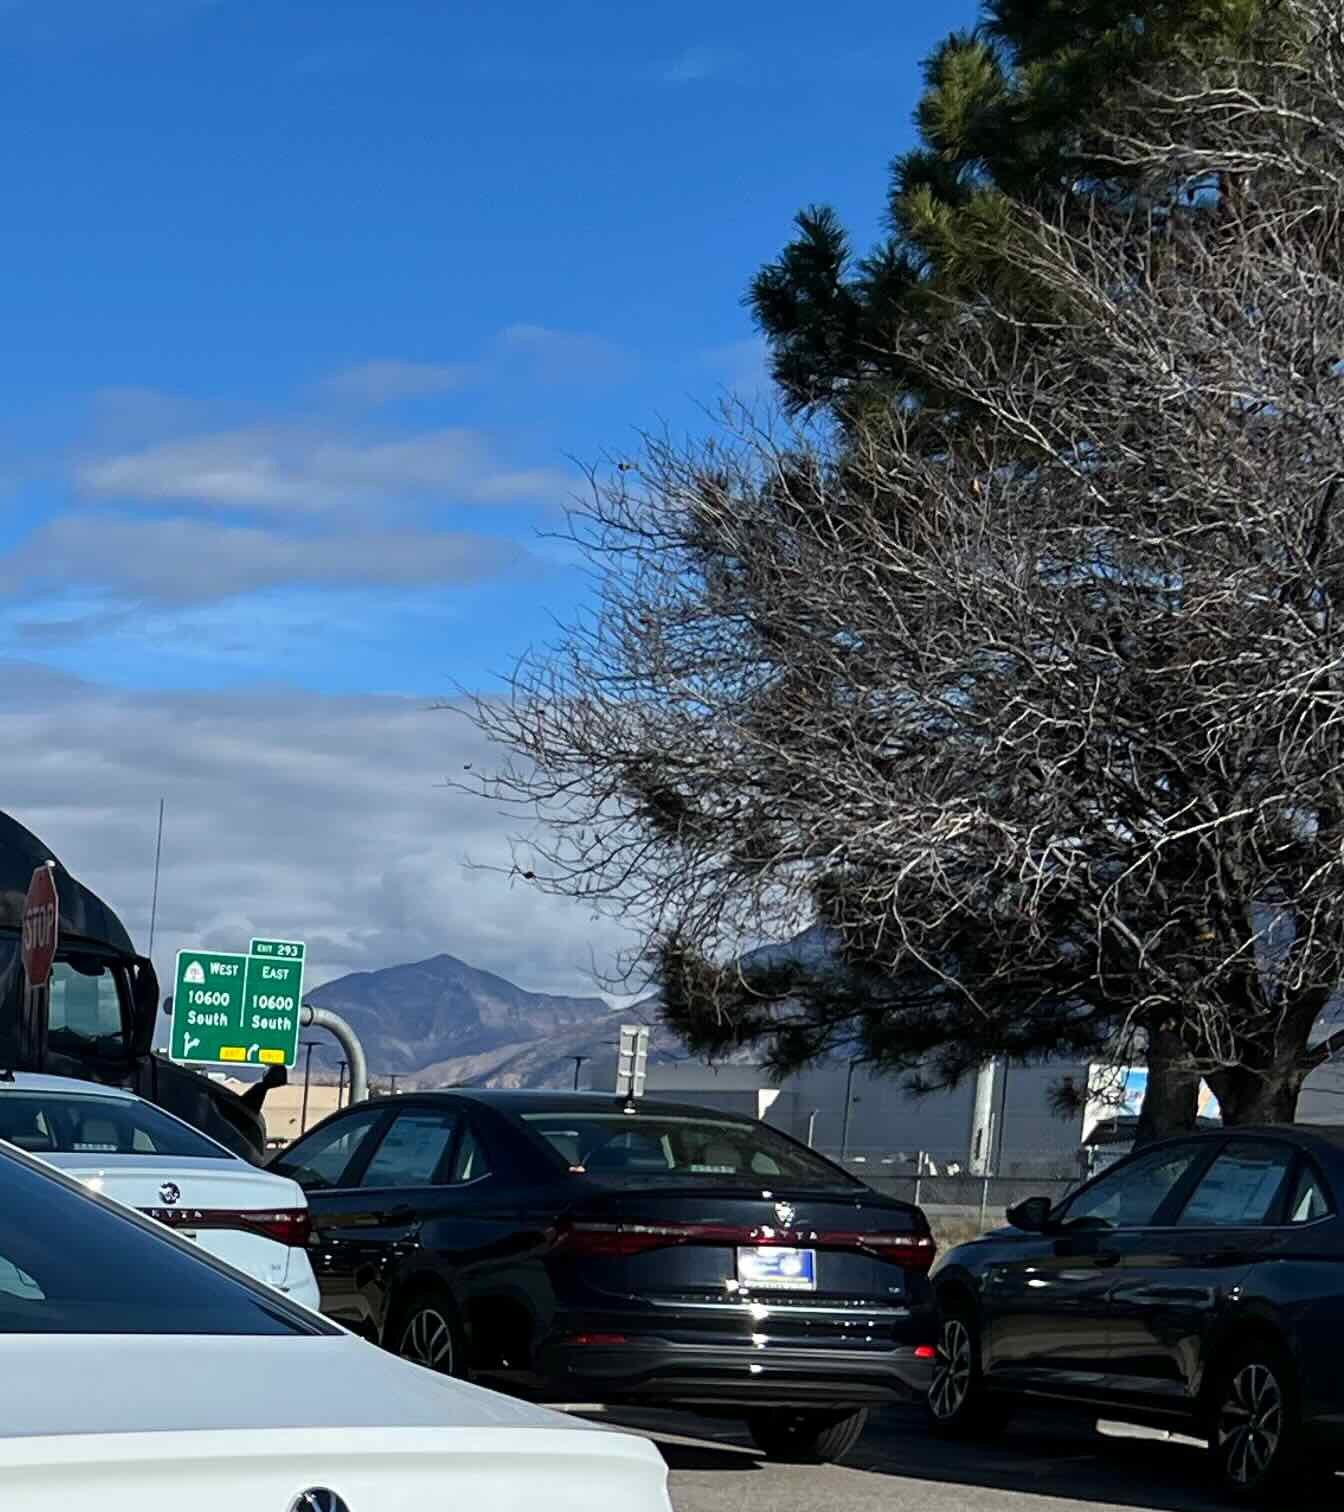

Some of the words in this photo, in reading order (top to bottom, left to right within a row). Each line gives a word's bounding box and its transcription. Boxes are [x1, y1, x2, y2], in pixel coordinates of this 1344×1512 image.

[23, 904, 54, 948] STOP
[277, 944, 298, 957] 293
[210, 961, 239, 976] WEST
[262, 966, 289, 980] EAST
[188, 990, 230, 1006] 10600
[253, 995, 294, 1011] 10600
[187, 1010, 228, 1027] South
[252, 1015, 291, 1031] South
